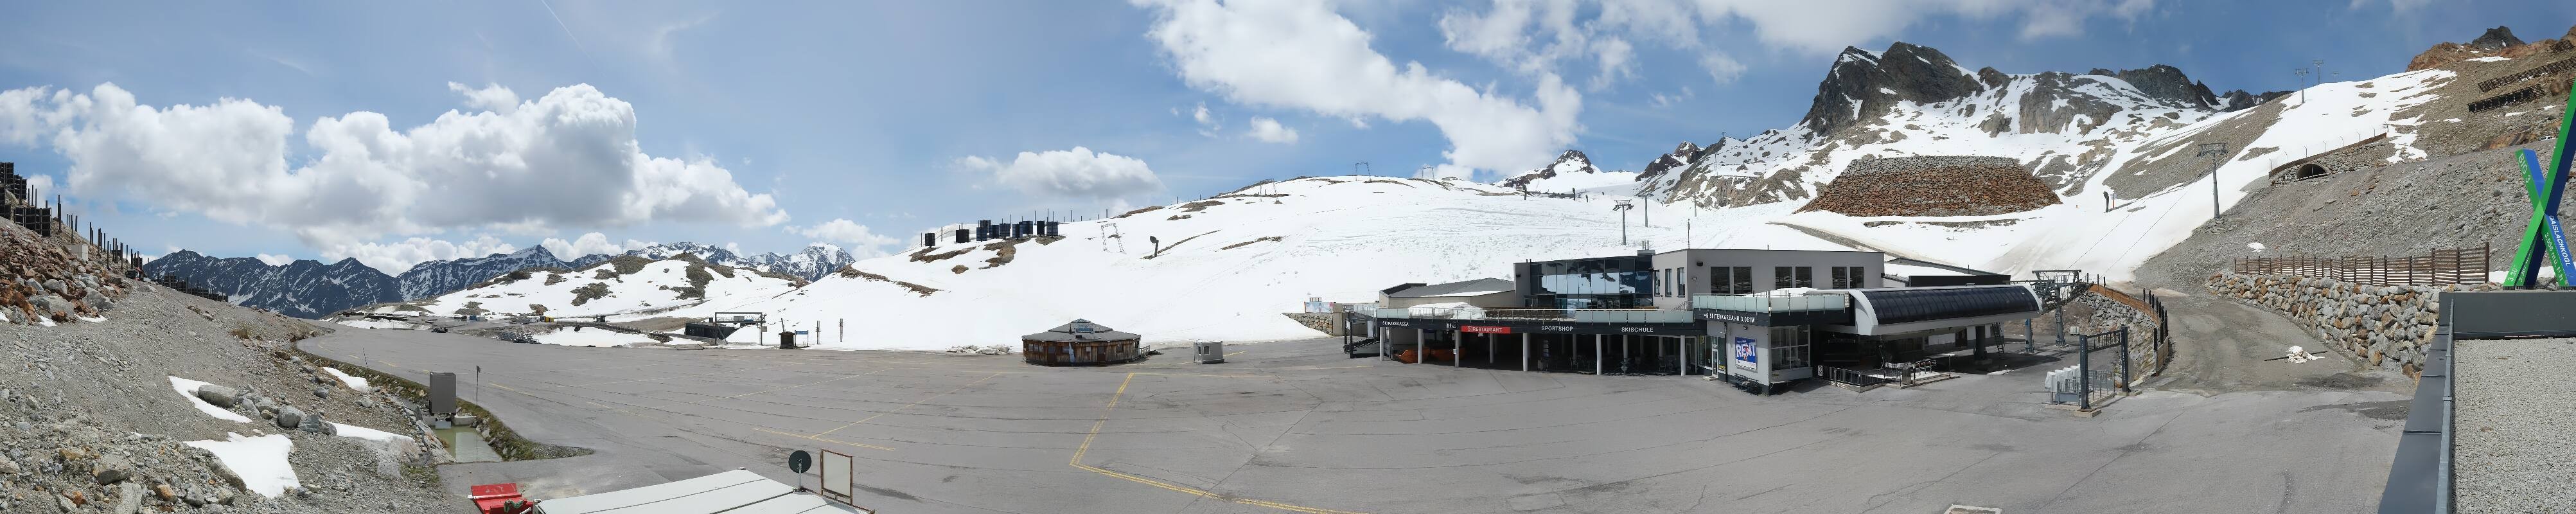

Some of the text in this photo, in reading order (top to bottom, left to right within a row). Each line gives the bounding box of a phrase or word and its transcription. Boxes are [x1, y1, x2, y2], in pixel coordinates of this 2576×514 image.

[2518, 152, 2530, 183] BIG 3
[2549, 215, 2570, 267] GAISLACHKOGL
[1736, 342, 1756, 358] RENT
